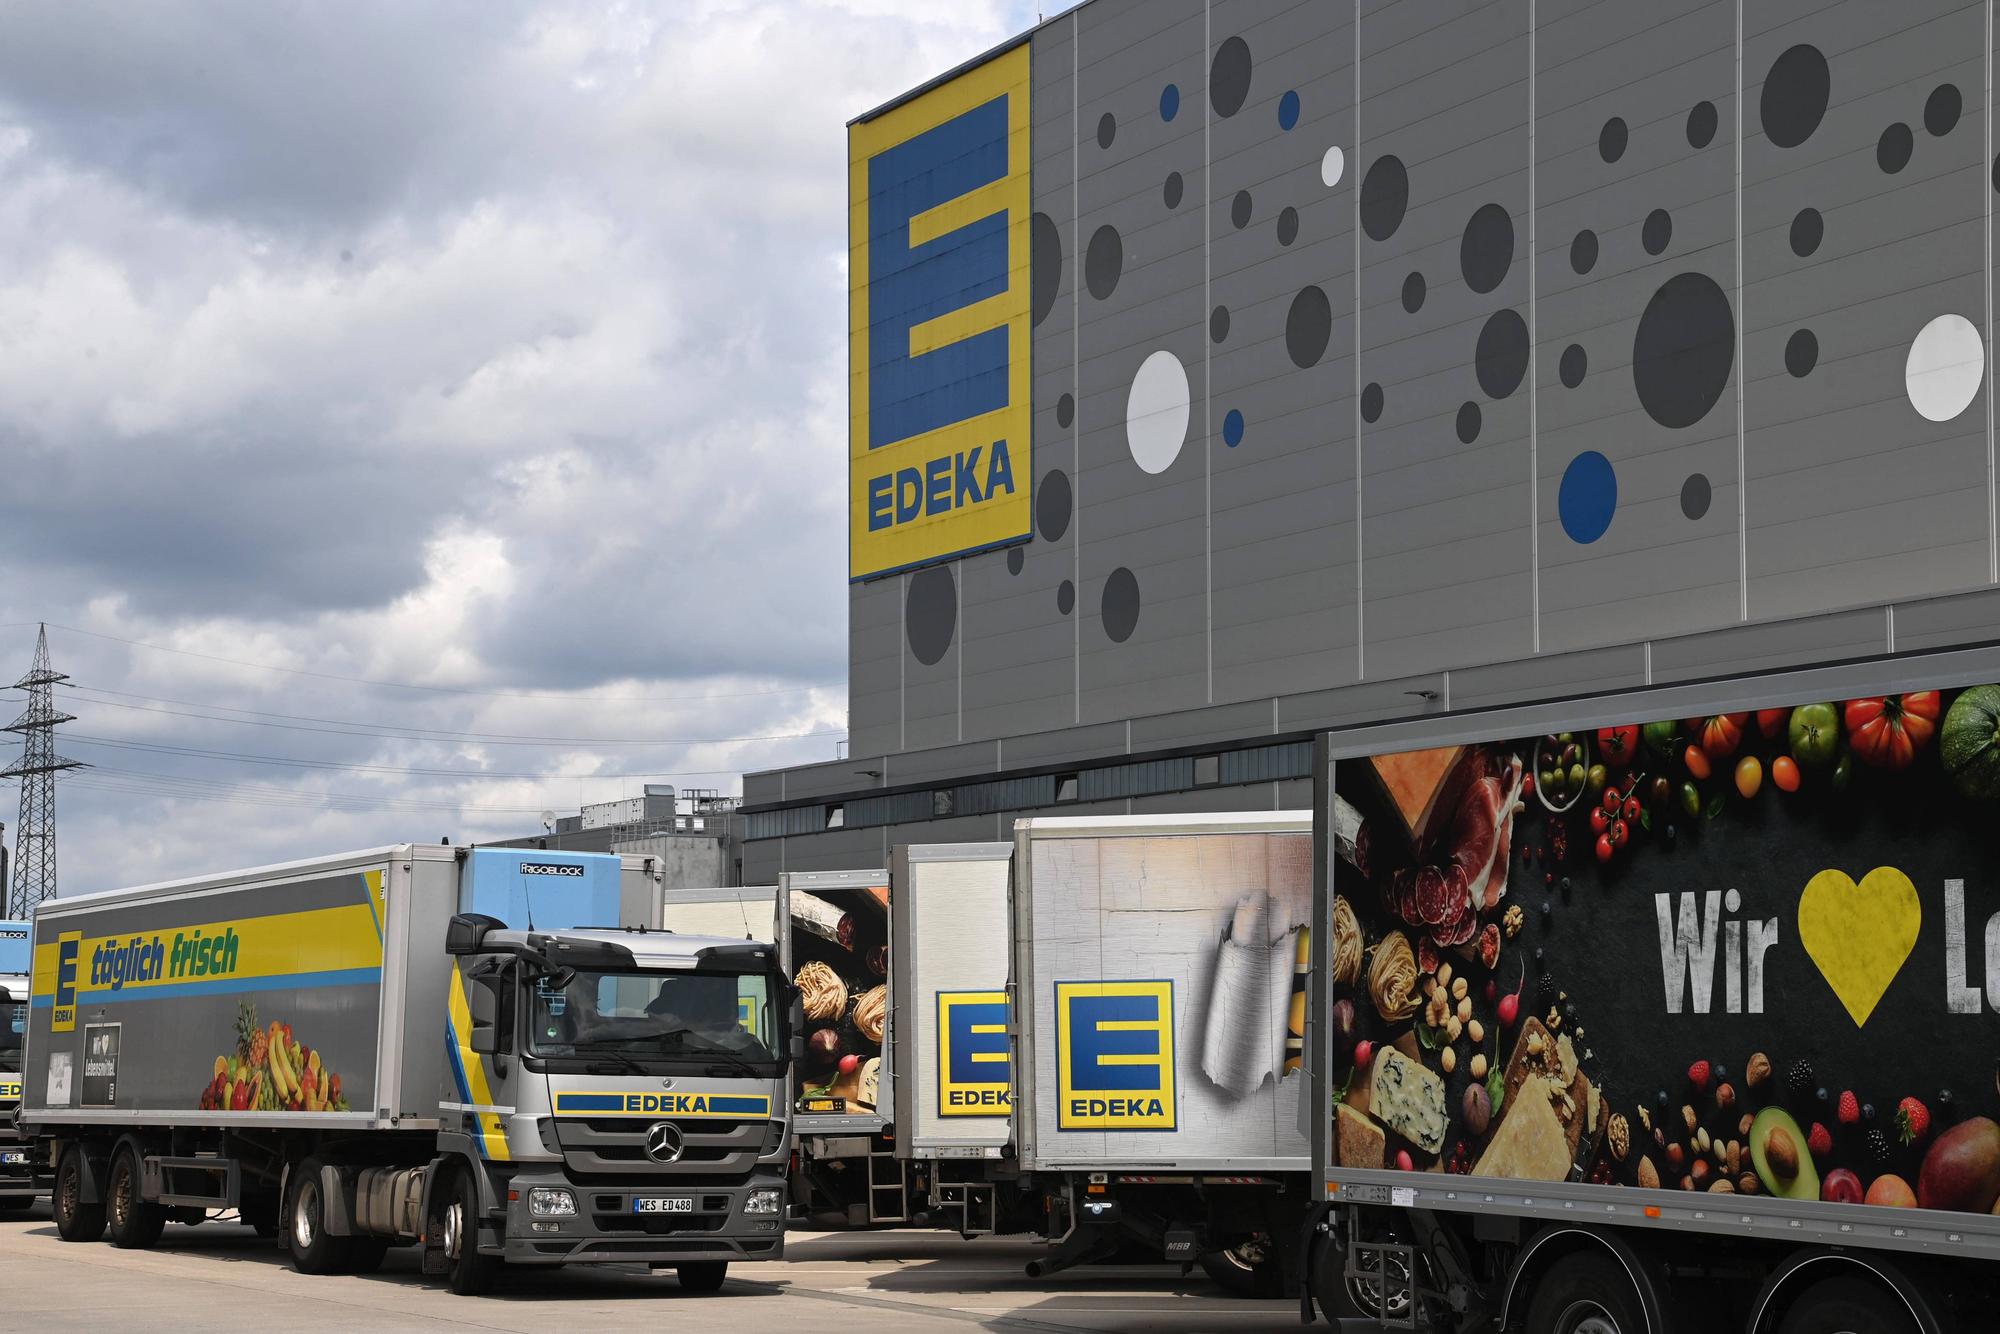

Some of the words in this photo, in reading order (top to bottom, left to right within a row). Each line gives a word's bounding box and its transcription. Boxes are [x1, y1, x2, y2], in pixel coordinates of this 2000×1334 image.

[867, 92, 1009, 450] E
[868, 439, 1015, 532] EDEKA
[521, 863, 583, 876] FRIGOBLOCK
[55, 940, 79, 1006] E
[90, 936, 165, 991] täglich
[169, 927, 239, 978] frisch
[1655, 888, 1778, 1014] Wir
[55, 1009, 73, 1022] EDEKA
[949, 1003, 1010, 1083] E
[1069, 995, 1160, 1090] E
[626, 1094, 708, 1112] EDEKA
[1070, 1099, 1165, 1117] EDEKA
[639, 1200, 657, 1211] WES
[1166, 1242, 1191, 1251] MBB
